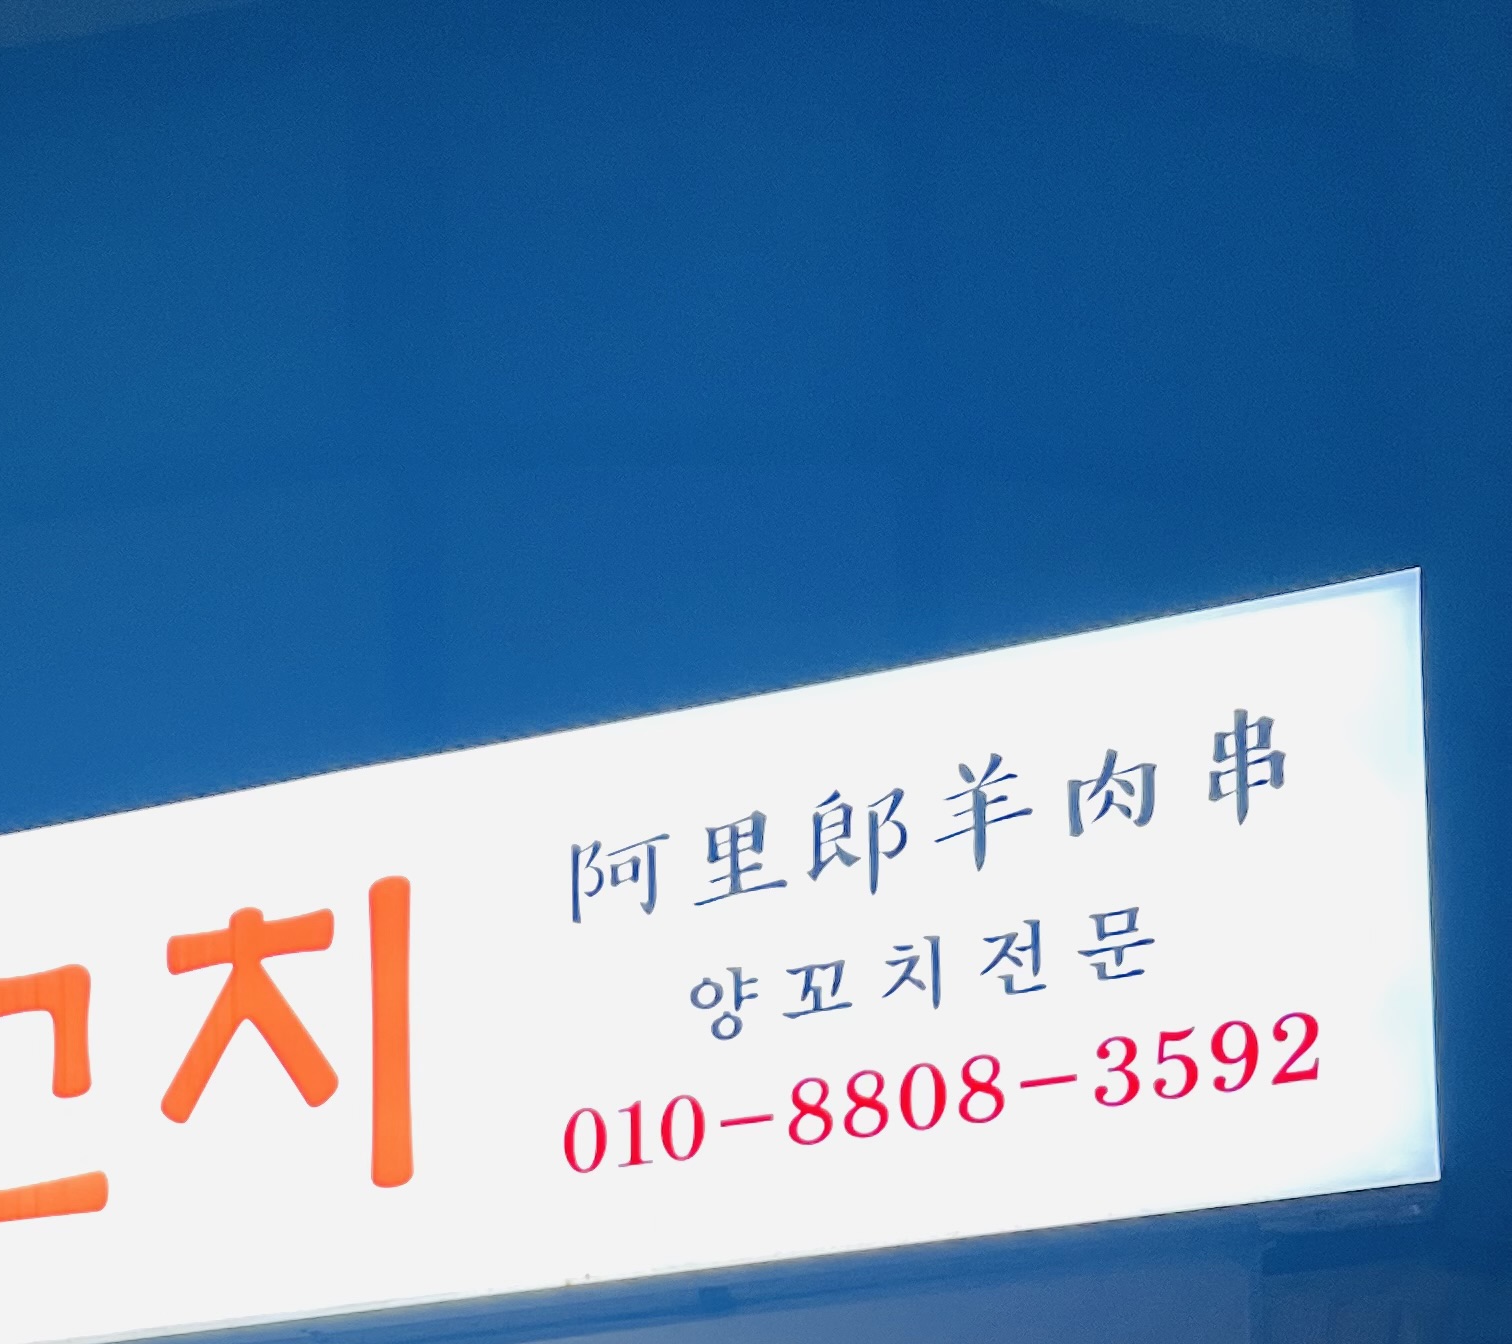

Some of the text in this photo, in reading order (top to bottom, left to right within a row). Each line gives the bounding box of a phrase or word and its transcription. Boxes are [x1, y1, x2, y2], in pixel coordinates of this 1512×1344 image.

[570, 708, 1286, 924] 阿里郎羊肉串
[689, 906, 1155, 1041] 양꼬치전문
[563, 1012, 1320, 1174] 010-8808-3592
